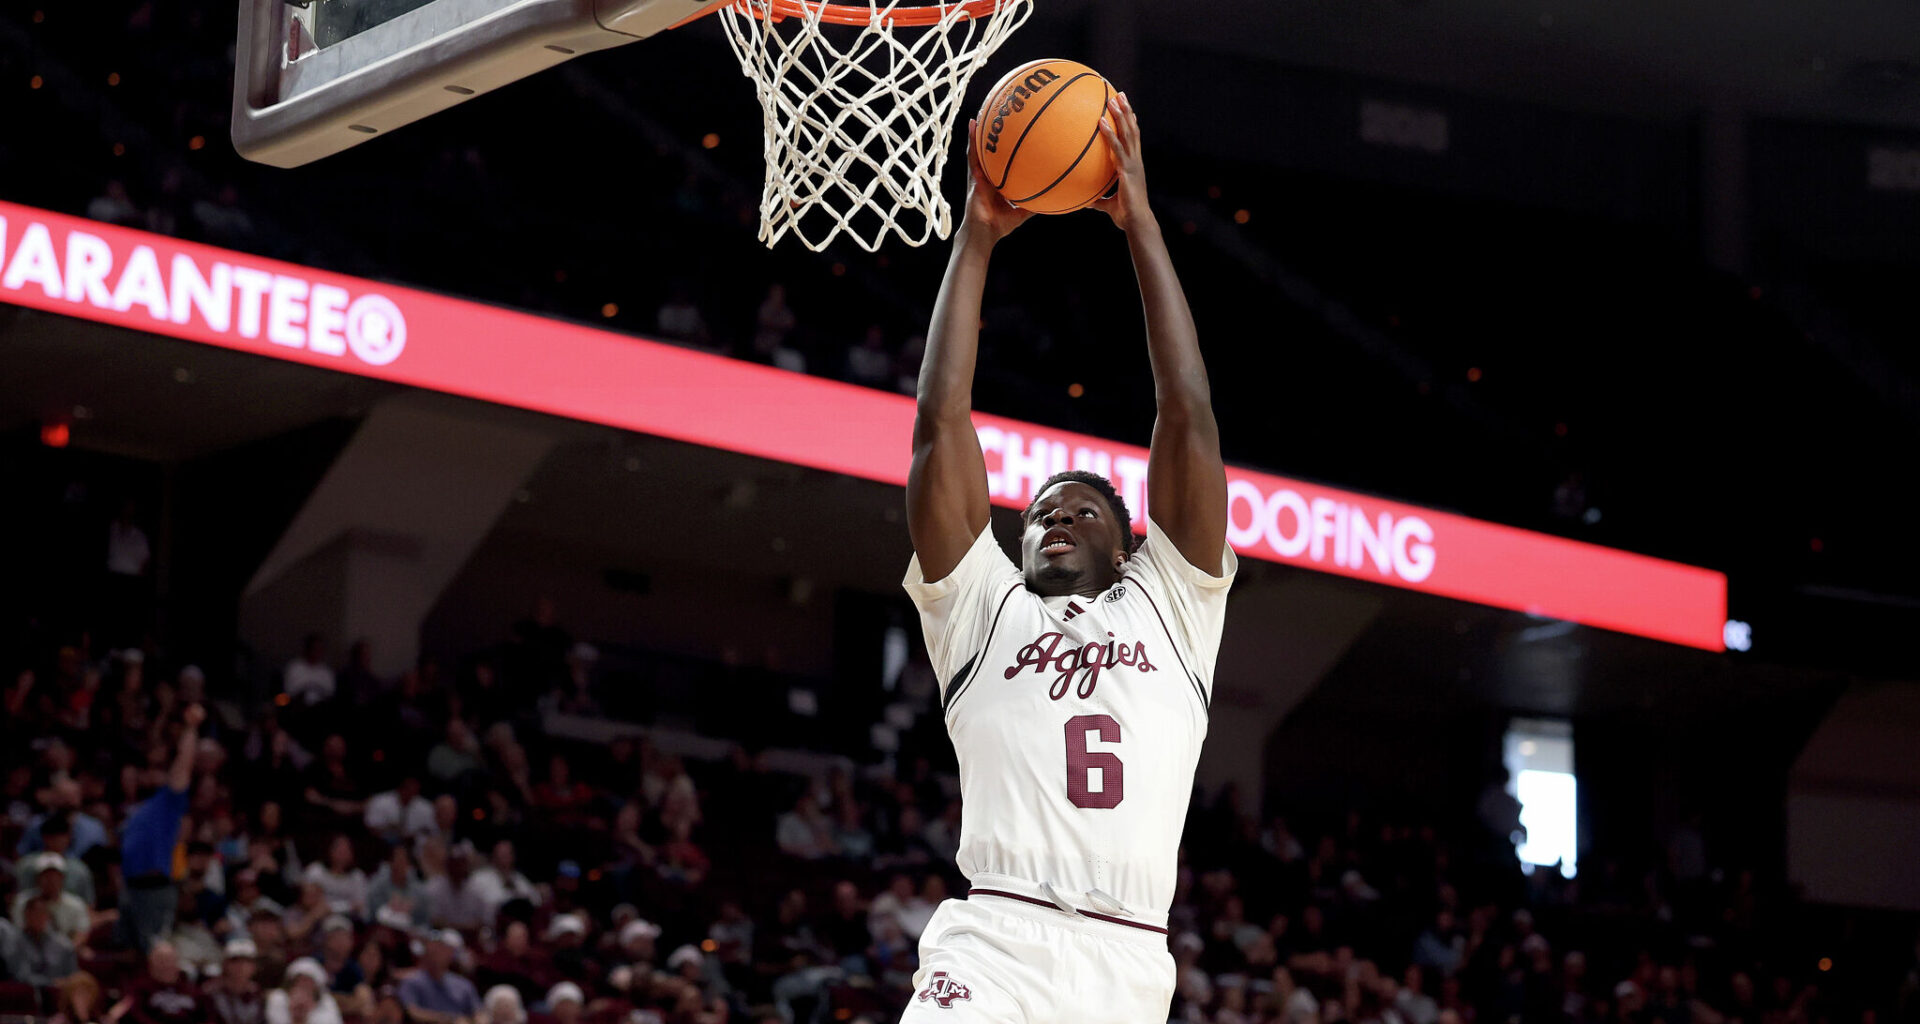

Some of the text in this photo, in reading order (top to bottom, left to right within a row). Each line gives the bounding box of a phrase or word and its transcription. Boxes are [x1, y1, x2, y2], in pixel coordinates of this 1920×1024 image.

[985, 68, 1061, 154] Wilson
[0, 214, 408, 366] ARANTEE®
[1106, 588, 1125, 602] SEC
[1003, 631, 1158, 701] Aggies
[1063, 714, 1124, 809] 6
